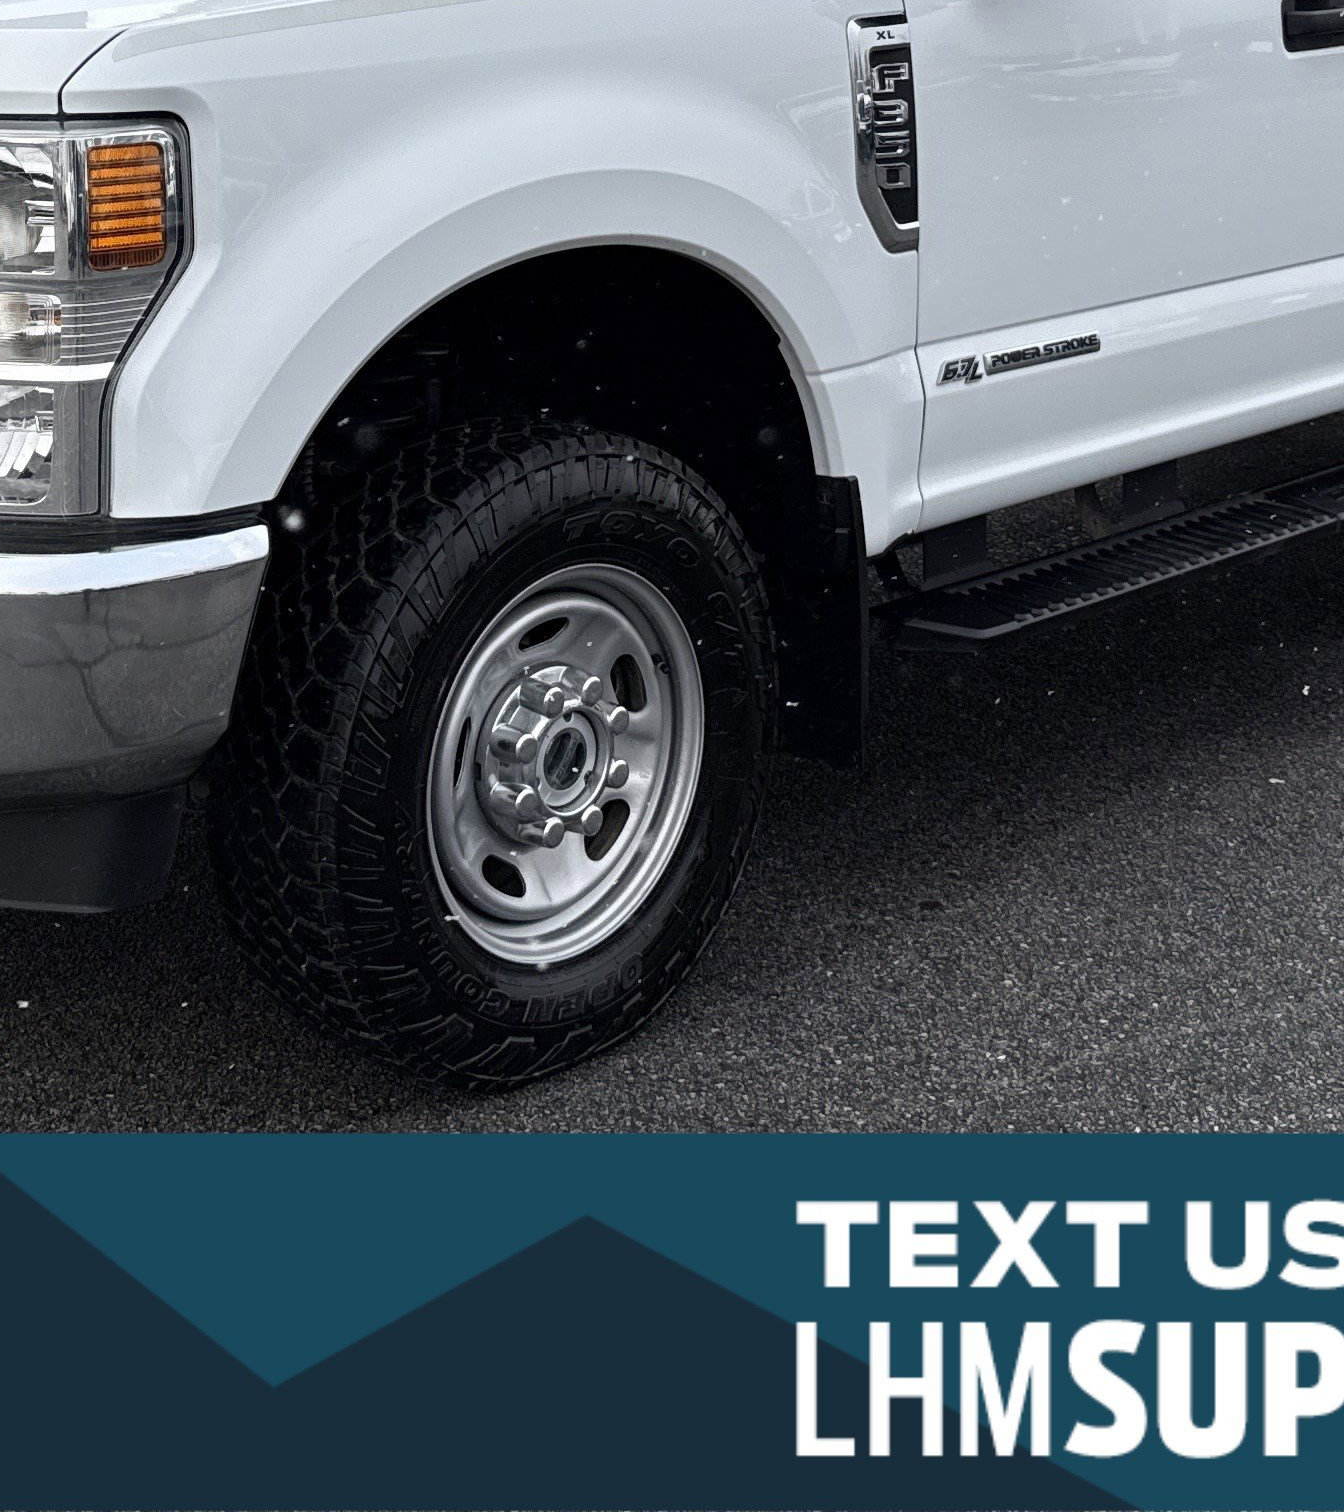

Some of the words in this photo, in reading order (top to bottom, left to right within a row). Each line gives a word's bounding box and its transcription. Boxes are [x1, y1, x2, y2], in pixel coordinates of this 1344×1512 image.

[876, 29, 895, 40] XL
[990, 346, 1042, 368] POWER
[1042, 333, 1099, 356] STROKE
[563, 510, 702, 569] TOYO
